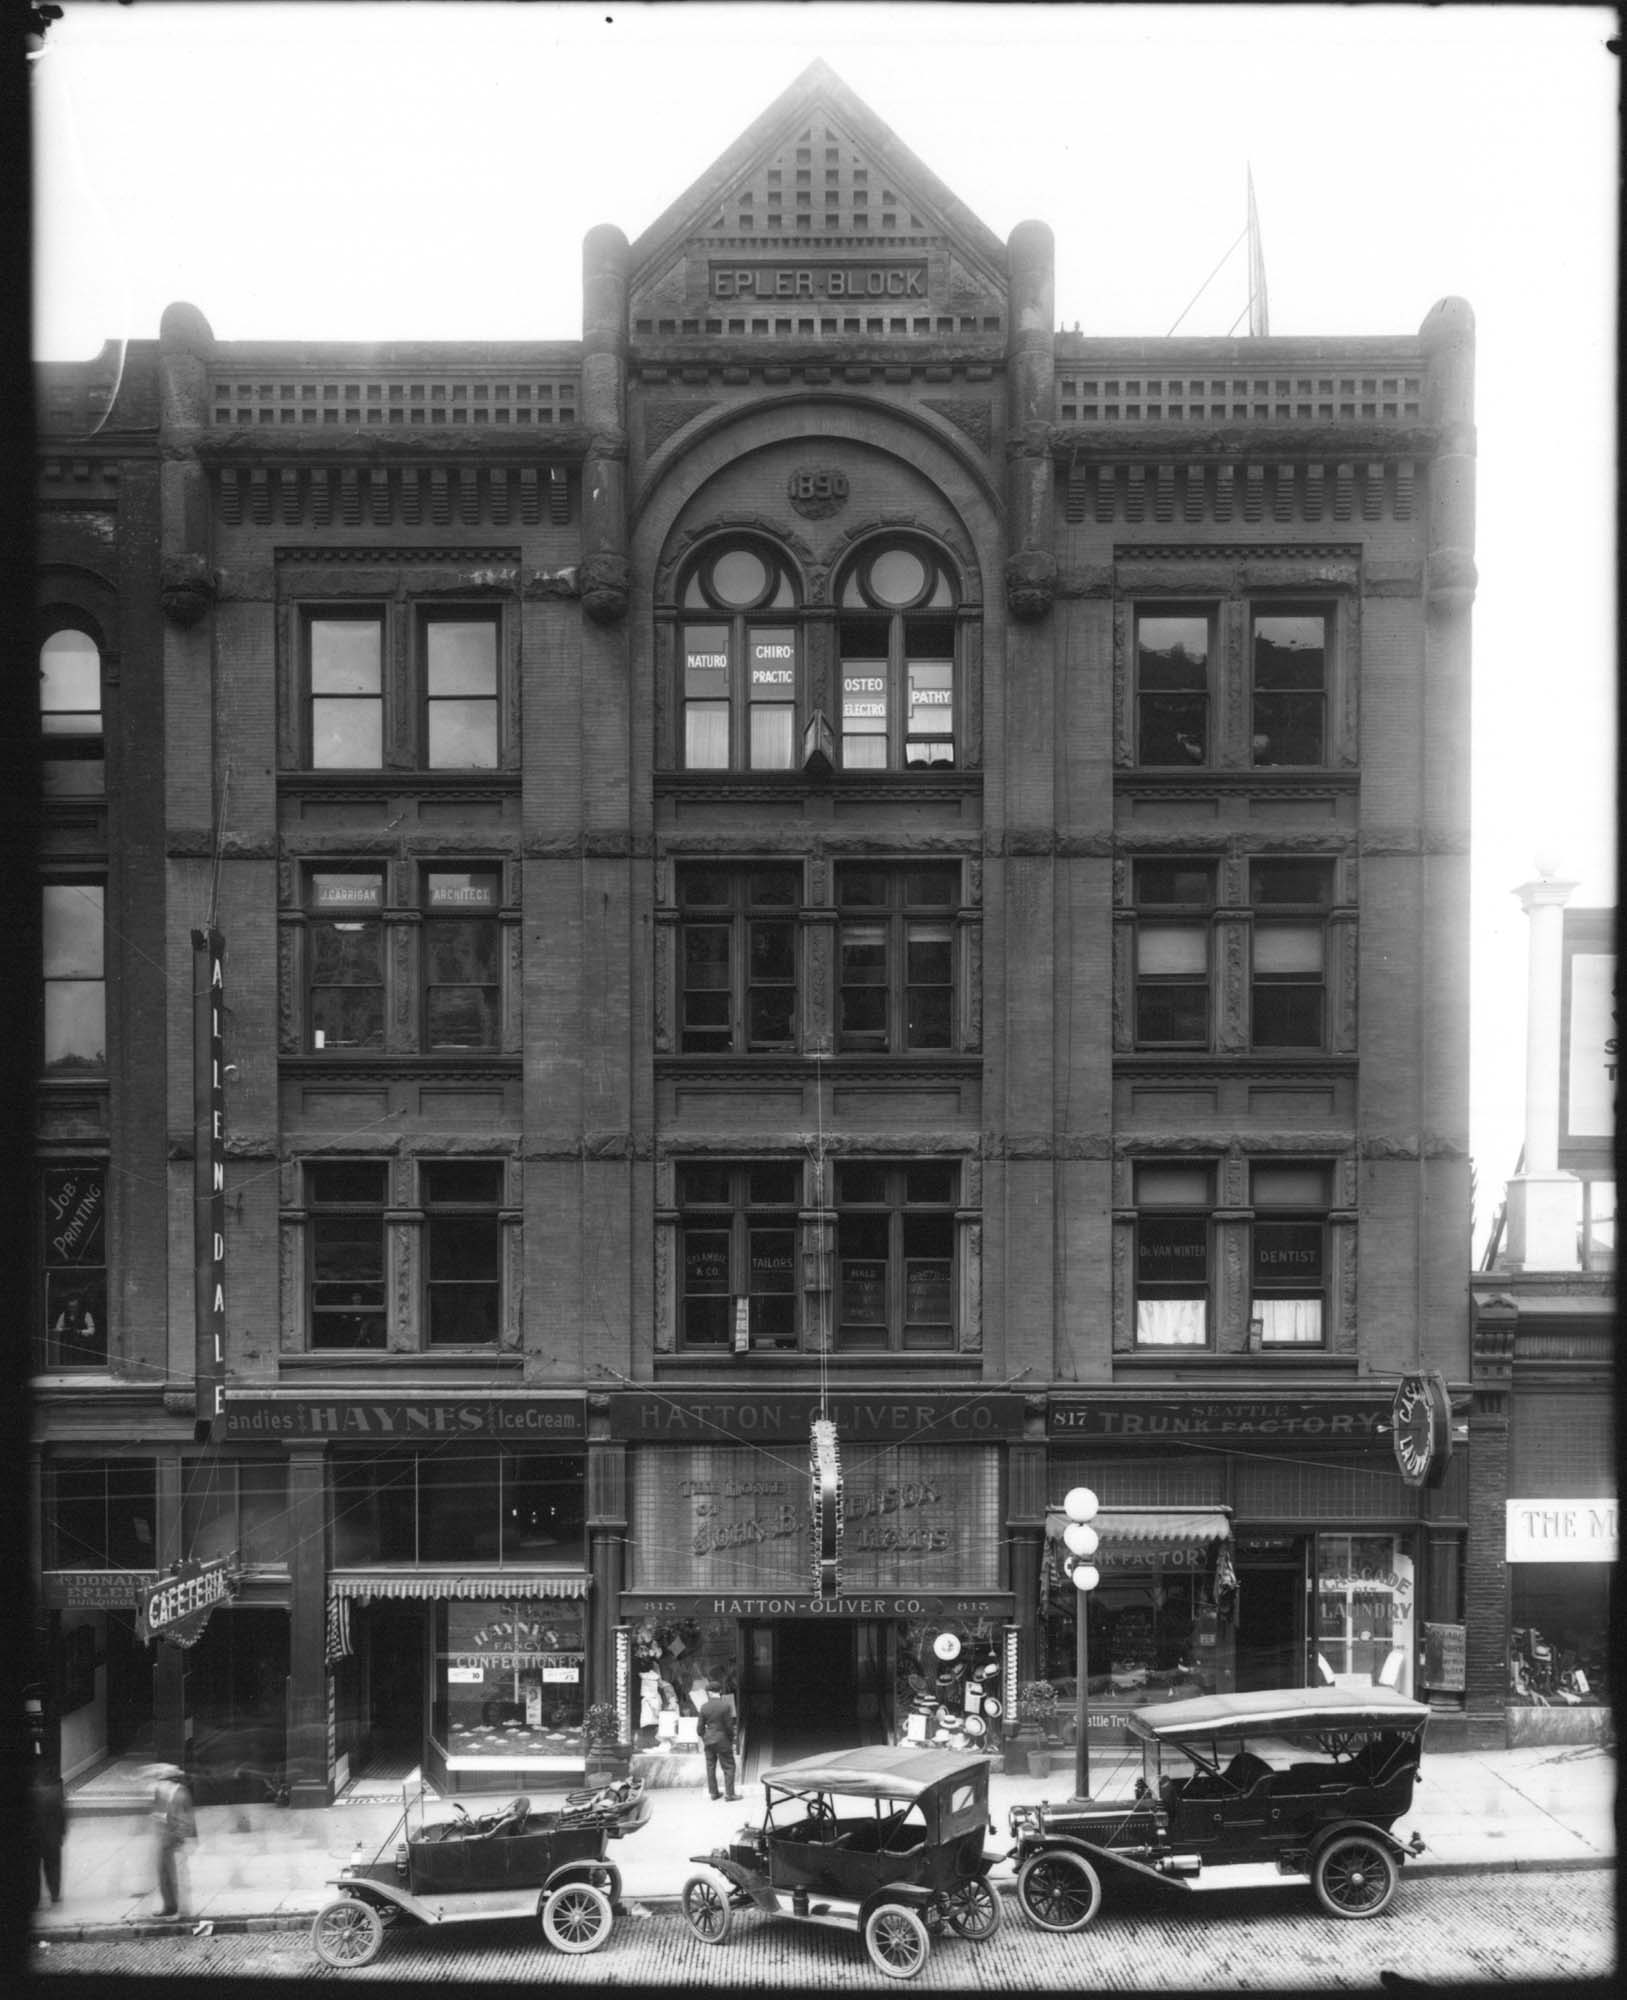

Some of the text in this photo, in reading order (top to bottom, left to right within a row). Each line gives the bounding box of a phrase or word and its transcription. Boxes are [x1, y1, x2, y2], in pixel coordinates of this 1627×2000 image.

[714, 271, 925, 297] EPLER BLOCK
[791, 474, 848, 499] 1890
[687, 654, 727, 669] NATURO
[752, 670, 793, 684] PRACTIC
[844, 677, 883, 692] OSTEO
[911, 689, 951, 704] PATHY
[843, 703, 886, 718] ELECTRO
[431, 886, 490, 901] ARCHITECT
[212, 958, 225, 1415] ALLENDALE
[48, 1180, 78, 1221] JOB
[52, 1183, 102, 1261] PRINTING
[752, 1257, 794, 1268] TAILORS
[1260, 1250, 1317, 1264] DENTIST
[228, 1412, 294, 1431] andies
[311, 1406, 484, 1432] HAYNES
[950, 1405, 999, 1429] CO.
[1053, 1411, 1087, 1427] 817
[1191, 1405, 1289, 1417] SEATTLE
[1097, 1411, 1382, 1434] TRUNK FACTORY
[1521, 1510, 1577, 1539] THE
[1321, 1567, 1413, 1596] CASCADE
[149, 1567, 229, 1629] CAFETERIA
[894, 1599, 926, 1614] CO.
[1321, 1602, 1413, 1620] LAUNDRY
[494, 1642, 542, 1651] FANCY
[1072, 1714, 1110, 1728] Sattle
